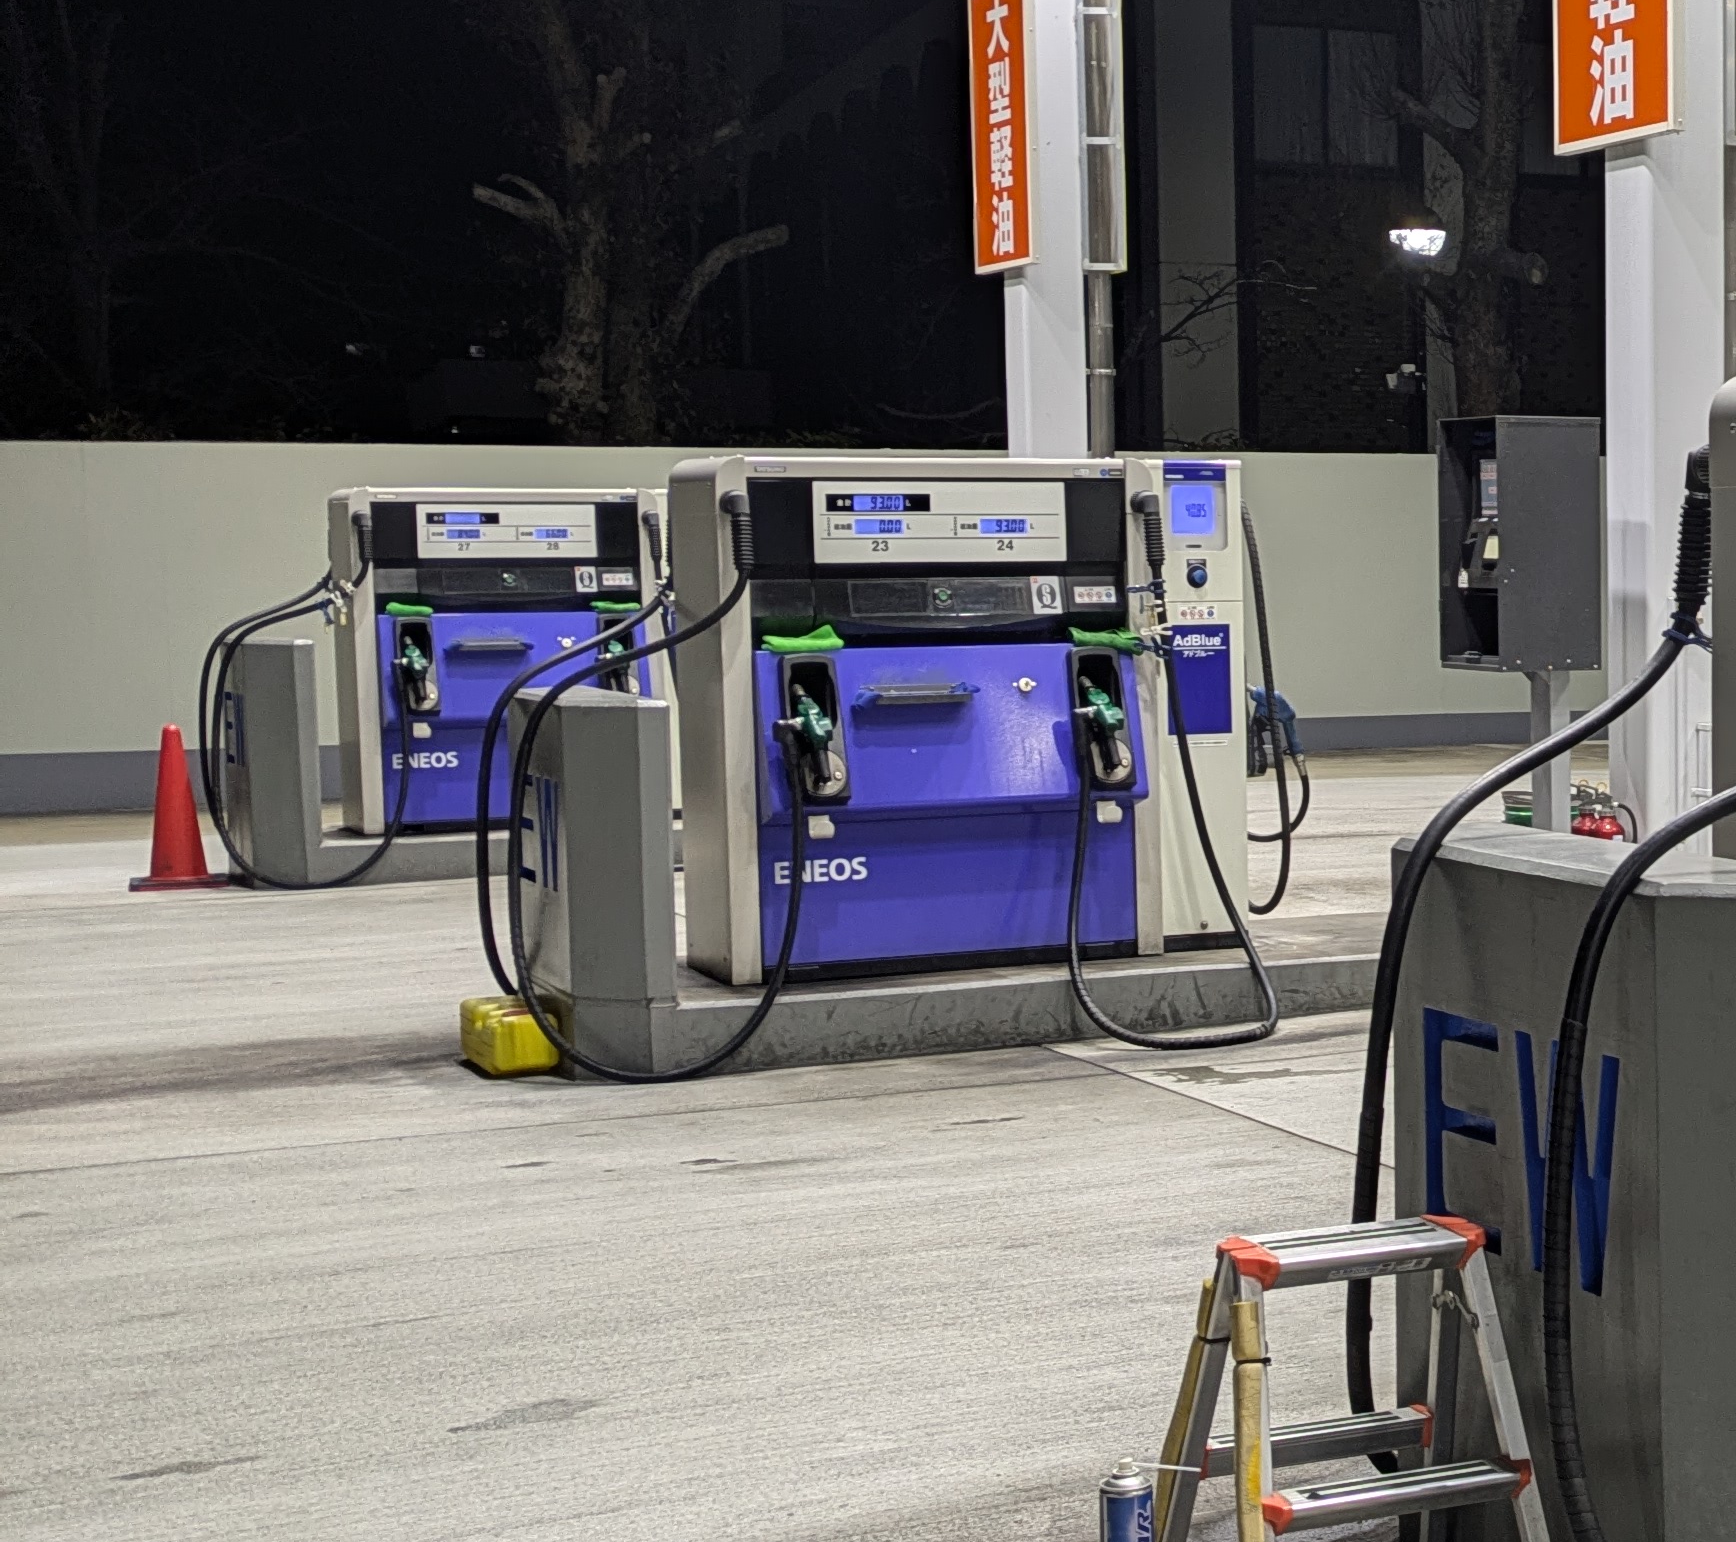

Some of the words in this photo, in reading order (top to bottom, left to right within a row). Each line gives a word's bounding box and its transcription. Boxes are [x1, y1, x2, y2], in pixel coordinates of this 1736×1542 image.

[869, 496, 901, 509] 93.00
[457, 542, 471, 551] 27
[547, 542, 560, 551] 28
[872, 540, 889, 552] 23
[997, 540, 1014, 551] 24
[1173, 634, 1222, 647] AdBlue
[392, 751, 459, 770] ENEOS
